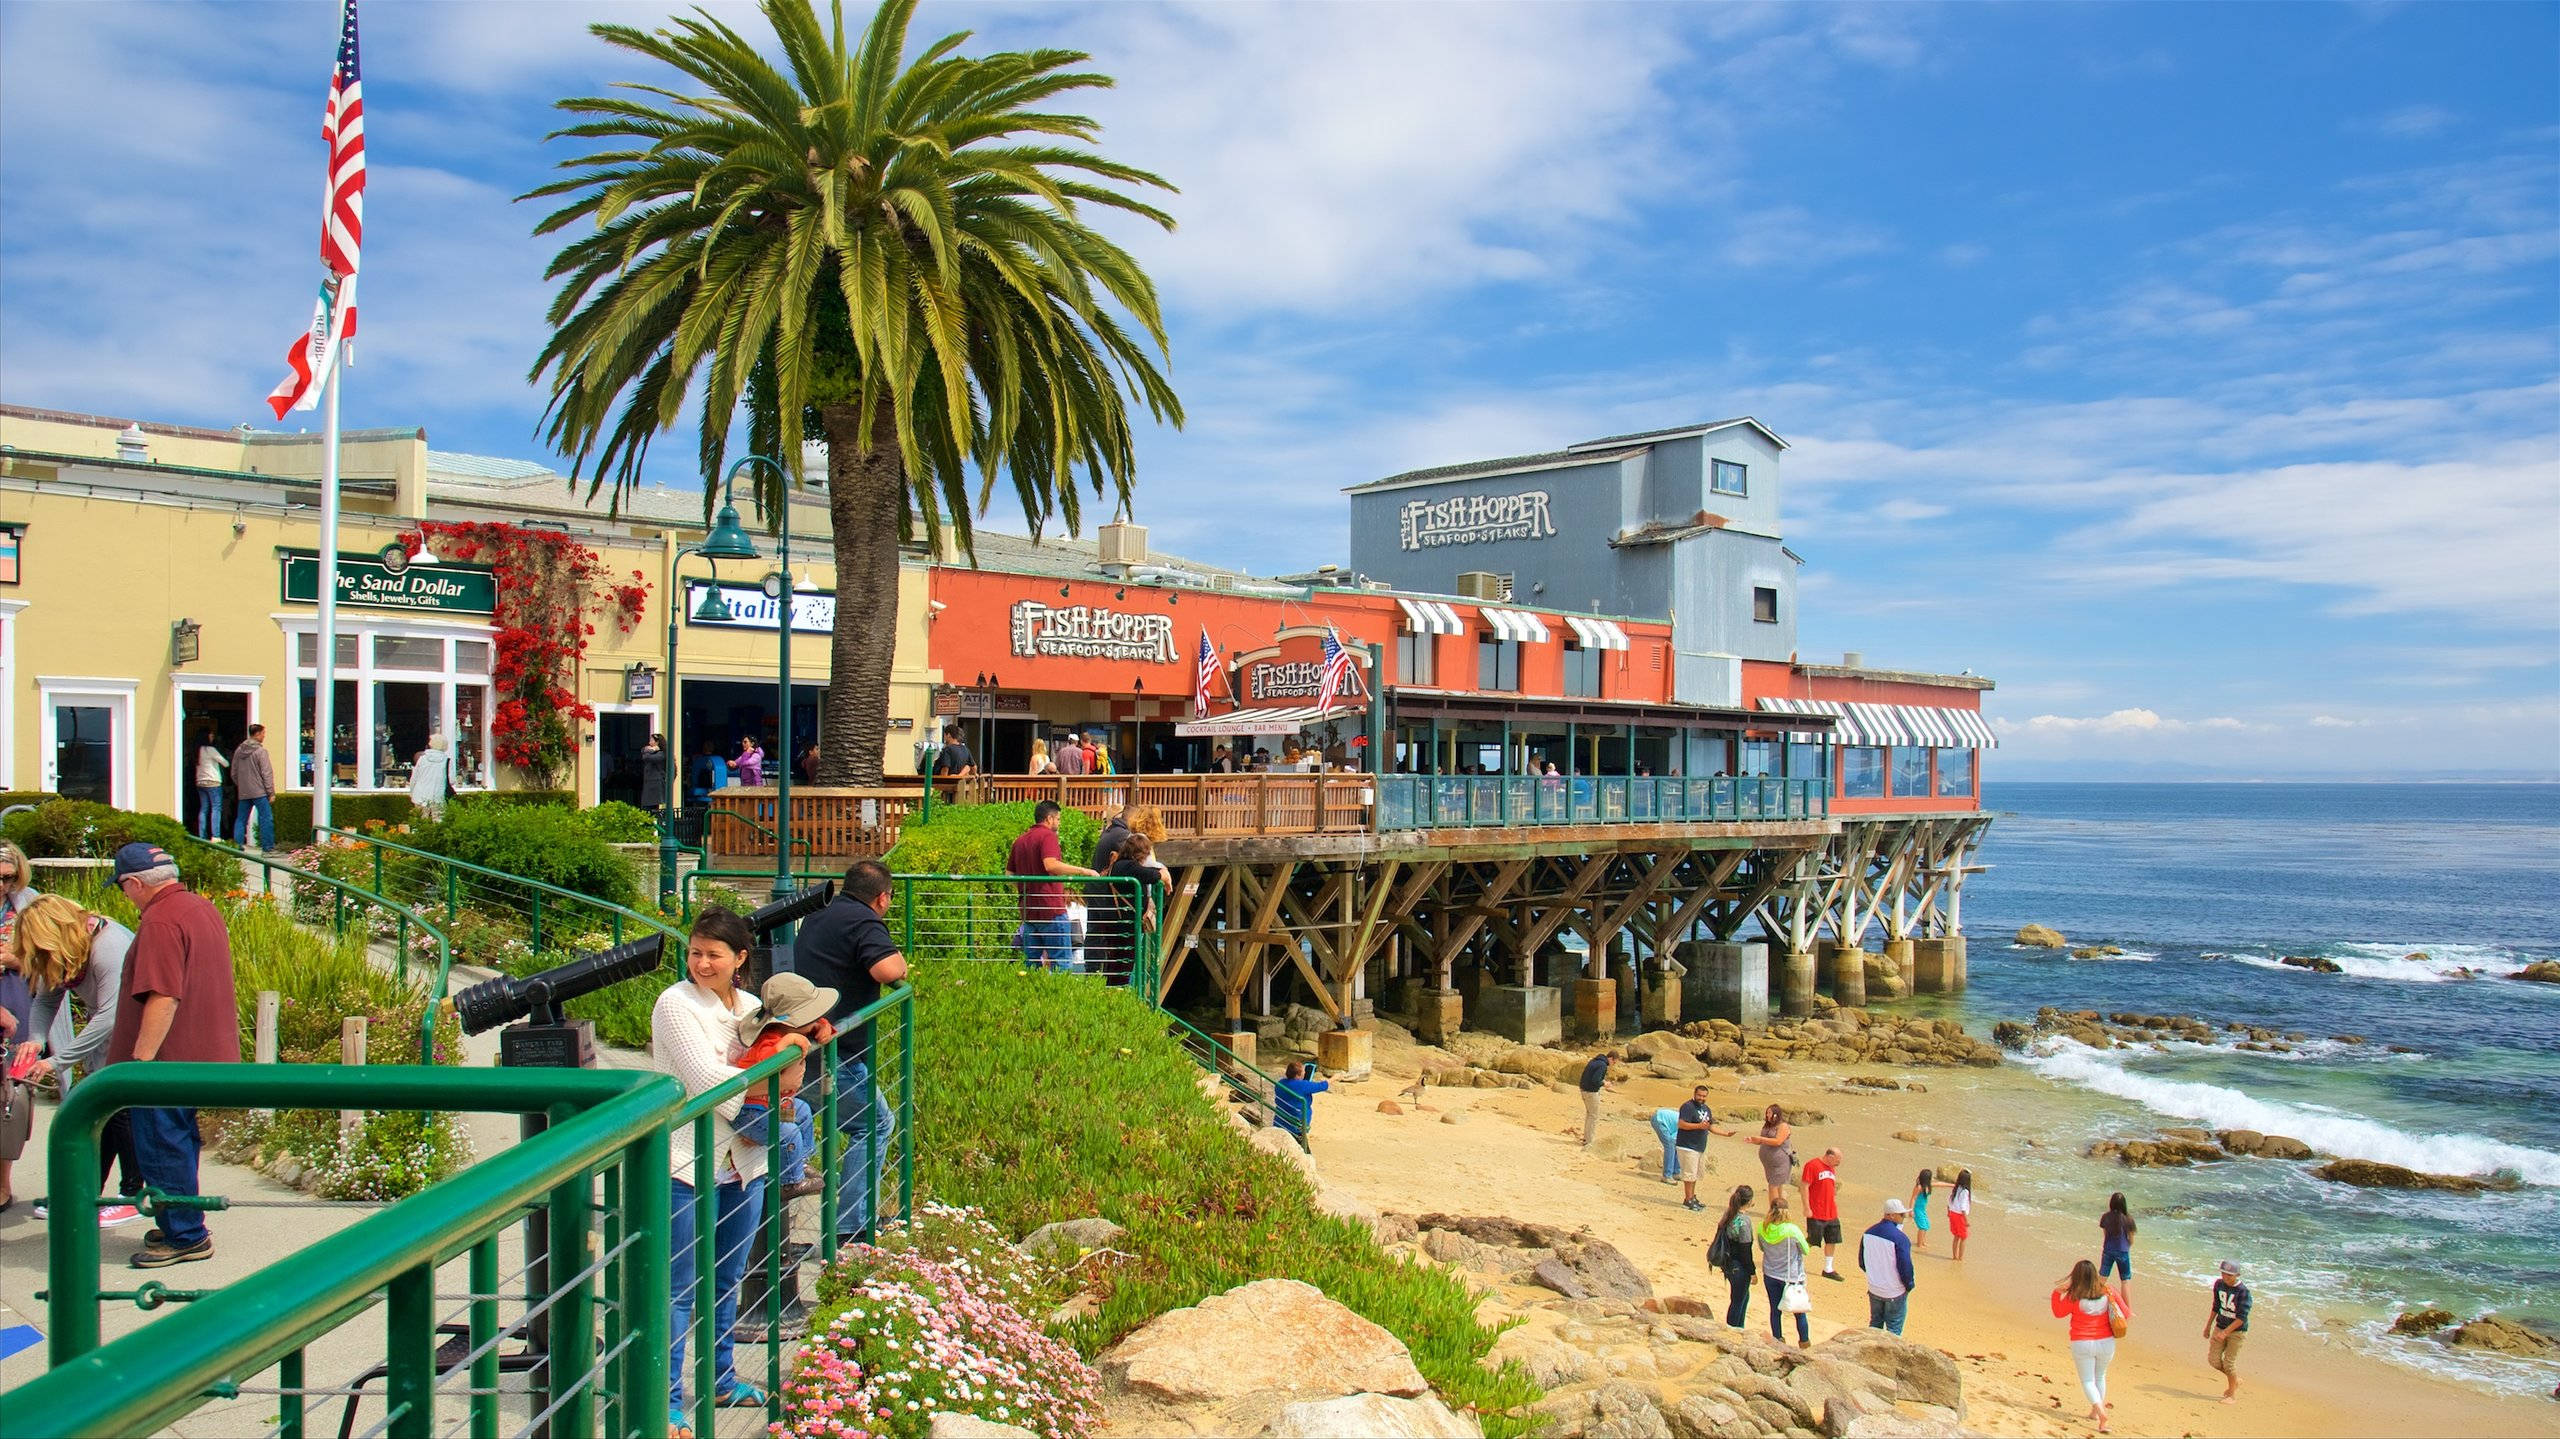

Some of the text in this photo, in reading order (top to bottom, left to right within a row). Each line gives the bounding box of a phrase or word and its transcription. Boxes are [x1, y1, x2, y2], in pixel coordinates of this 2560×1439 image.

[315, 315, 325, 366] REPUBL
[1401, 507, 1411, 549] THE
[1408, 491, 1556, 550] FISH HOPPER
[335, 571, 465, 596] he Sand Dollar
[350, 591, 440, 606] Shells, Jewelry, Gifts
[727, 598, 797, 621] italiy
[1012, 605, 1025, 653] THE
[1021, 601, 1179, 661] FISH HOPPER
[1257, 663, 1359, 698] FISH HOR
[1186, 725, 1216, 733] COCKTAIL
